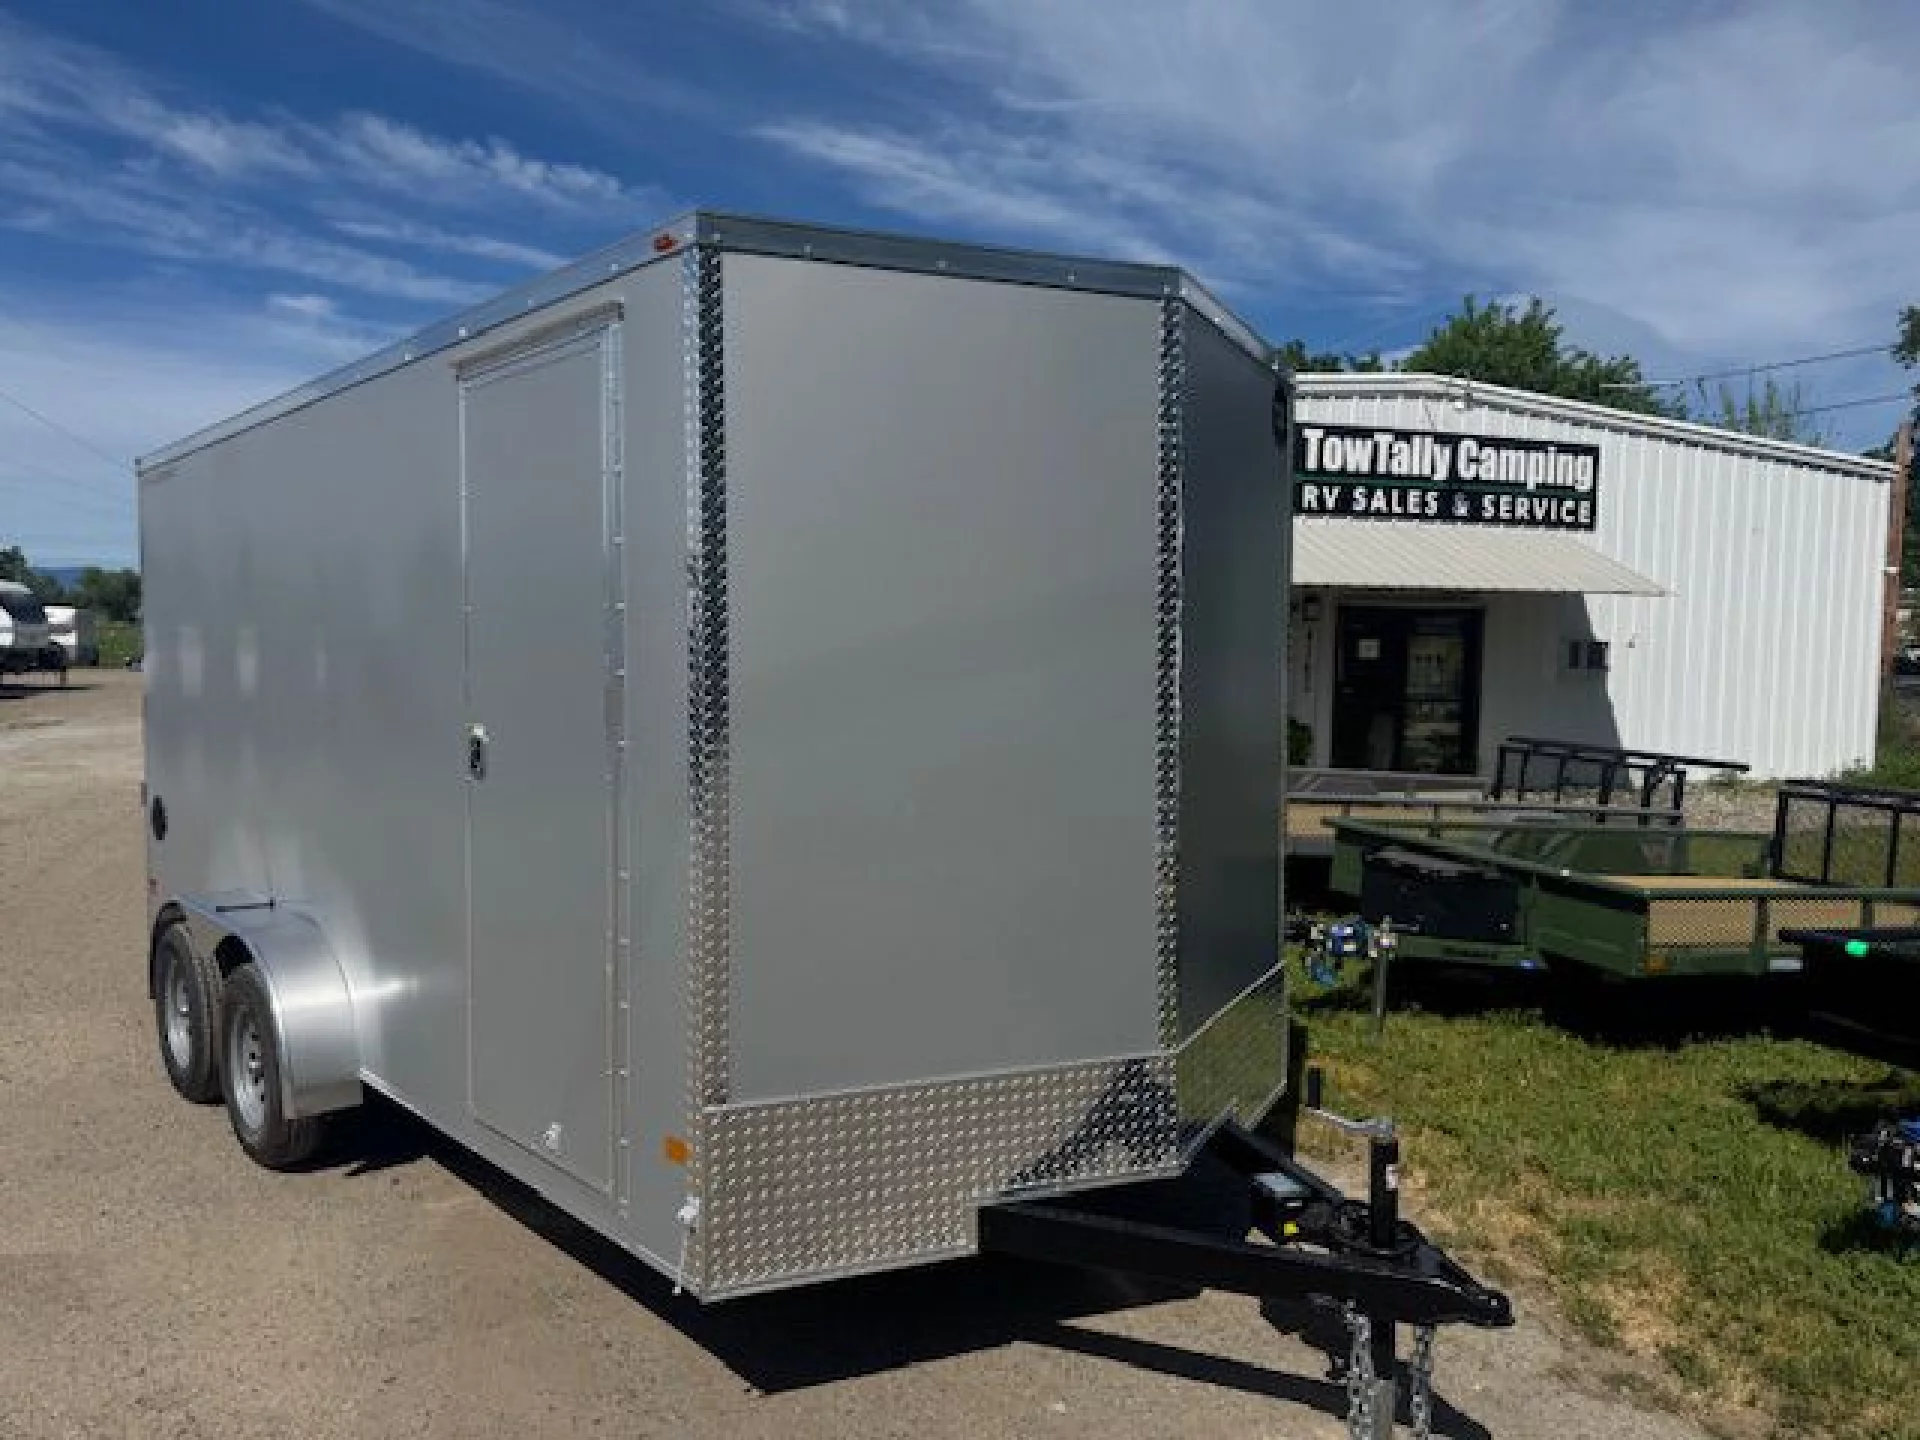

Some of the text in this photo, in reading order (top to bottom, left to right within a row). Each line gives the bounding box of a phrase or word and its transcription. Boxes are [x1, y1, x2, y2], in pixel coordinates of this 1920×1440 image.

[1302, 428, 1594, 490] TowTally Camping
[1302, 485, 1591, 523] RV SALES & SERVICE
